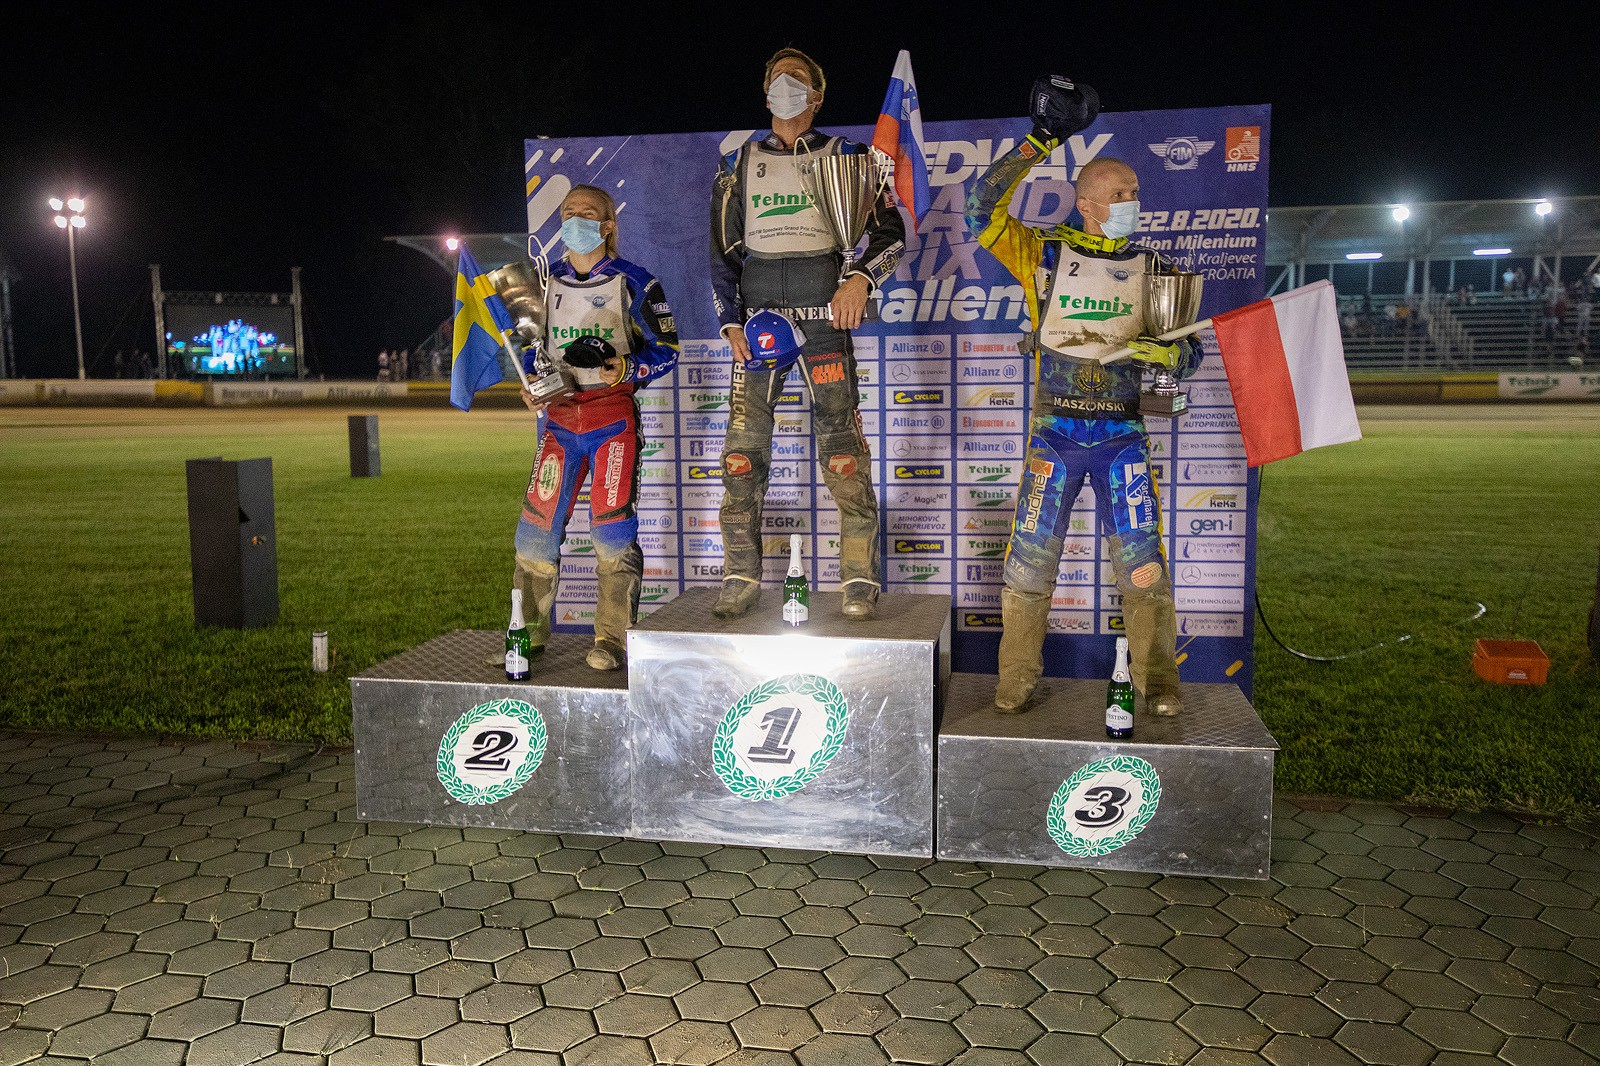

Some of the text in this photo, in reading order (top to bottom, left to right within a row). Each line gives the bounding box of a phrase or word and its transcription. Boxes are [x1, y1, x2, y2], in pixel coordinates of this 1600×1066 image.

[1171, 148, 1192, 160] FIM
[756, 163, 767, 178] 3
[1226, 163, 1256, 172] HMS
[1175, 234, 1257, 250] Milenium
[1197, 252, 1257, 267] Kraljevec
[1068, 261, 1080, 277] 2
[1201, 267, 1256, 281] CROATIA
[554, 294, 563, 309] 7
[1059, 294, 1133, 315] Tehnix
[552, 323, 614, 340] Tehnix
[892, 342, 928, 352] Allianz
[963, 367, 1000, 377] Allianz
[703, 417, 728, 430] Pavl
[893, 417, 929, 427] Allianz
[963, 442, 1000, 451] Allianz
[968, 464, 1011, 474] Tehnix
[969, 489, 1012, 499] Tehnix
[1190, 514, 1233, 536] gen-i
[561, 564, 594, 573] Allianz
[692, 565, 725, 576] TEGR
[899, 563, 940, 572] Tehnix
[1059, 570, 1089, 580] avlic
[963, 593, 1000, 602] Allianz
[747, 706, 803, 765] 1
[464, 729, 519, 774] 2
[1074, 784, 1133, 830] 3
